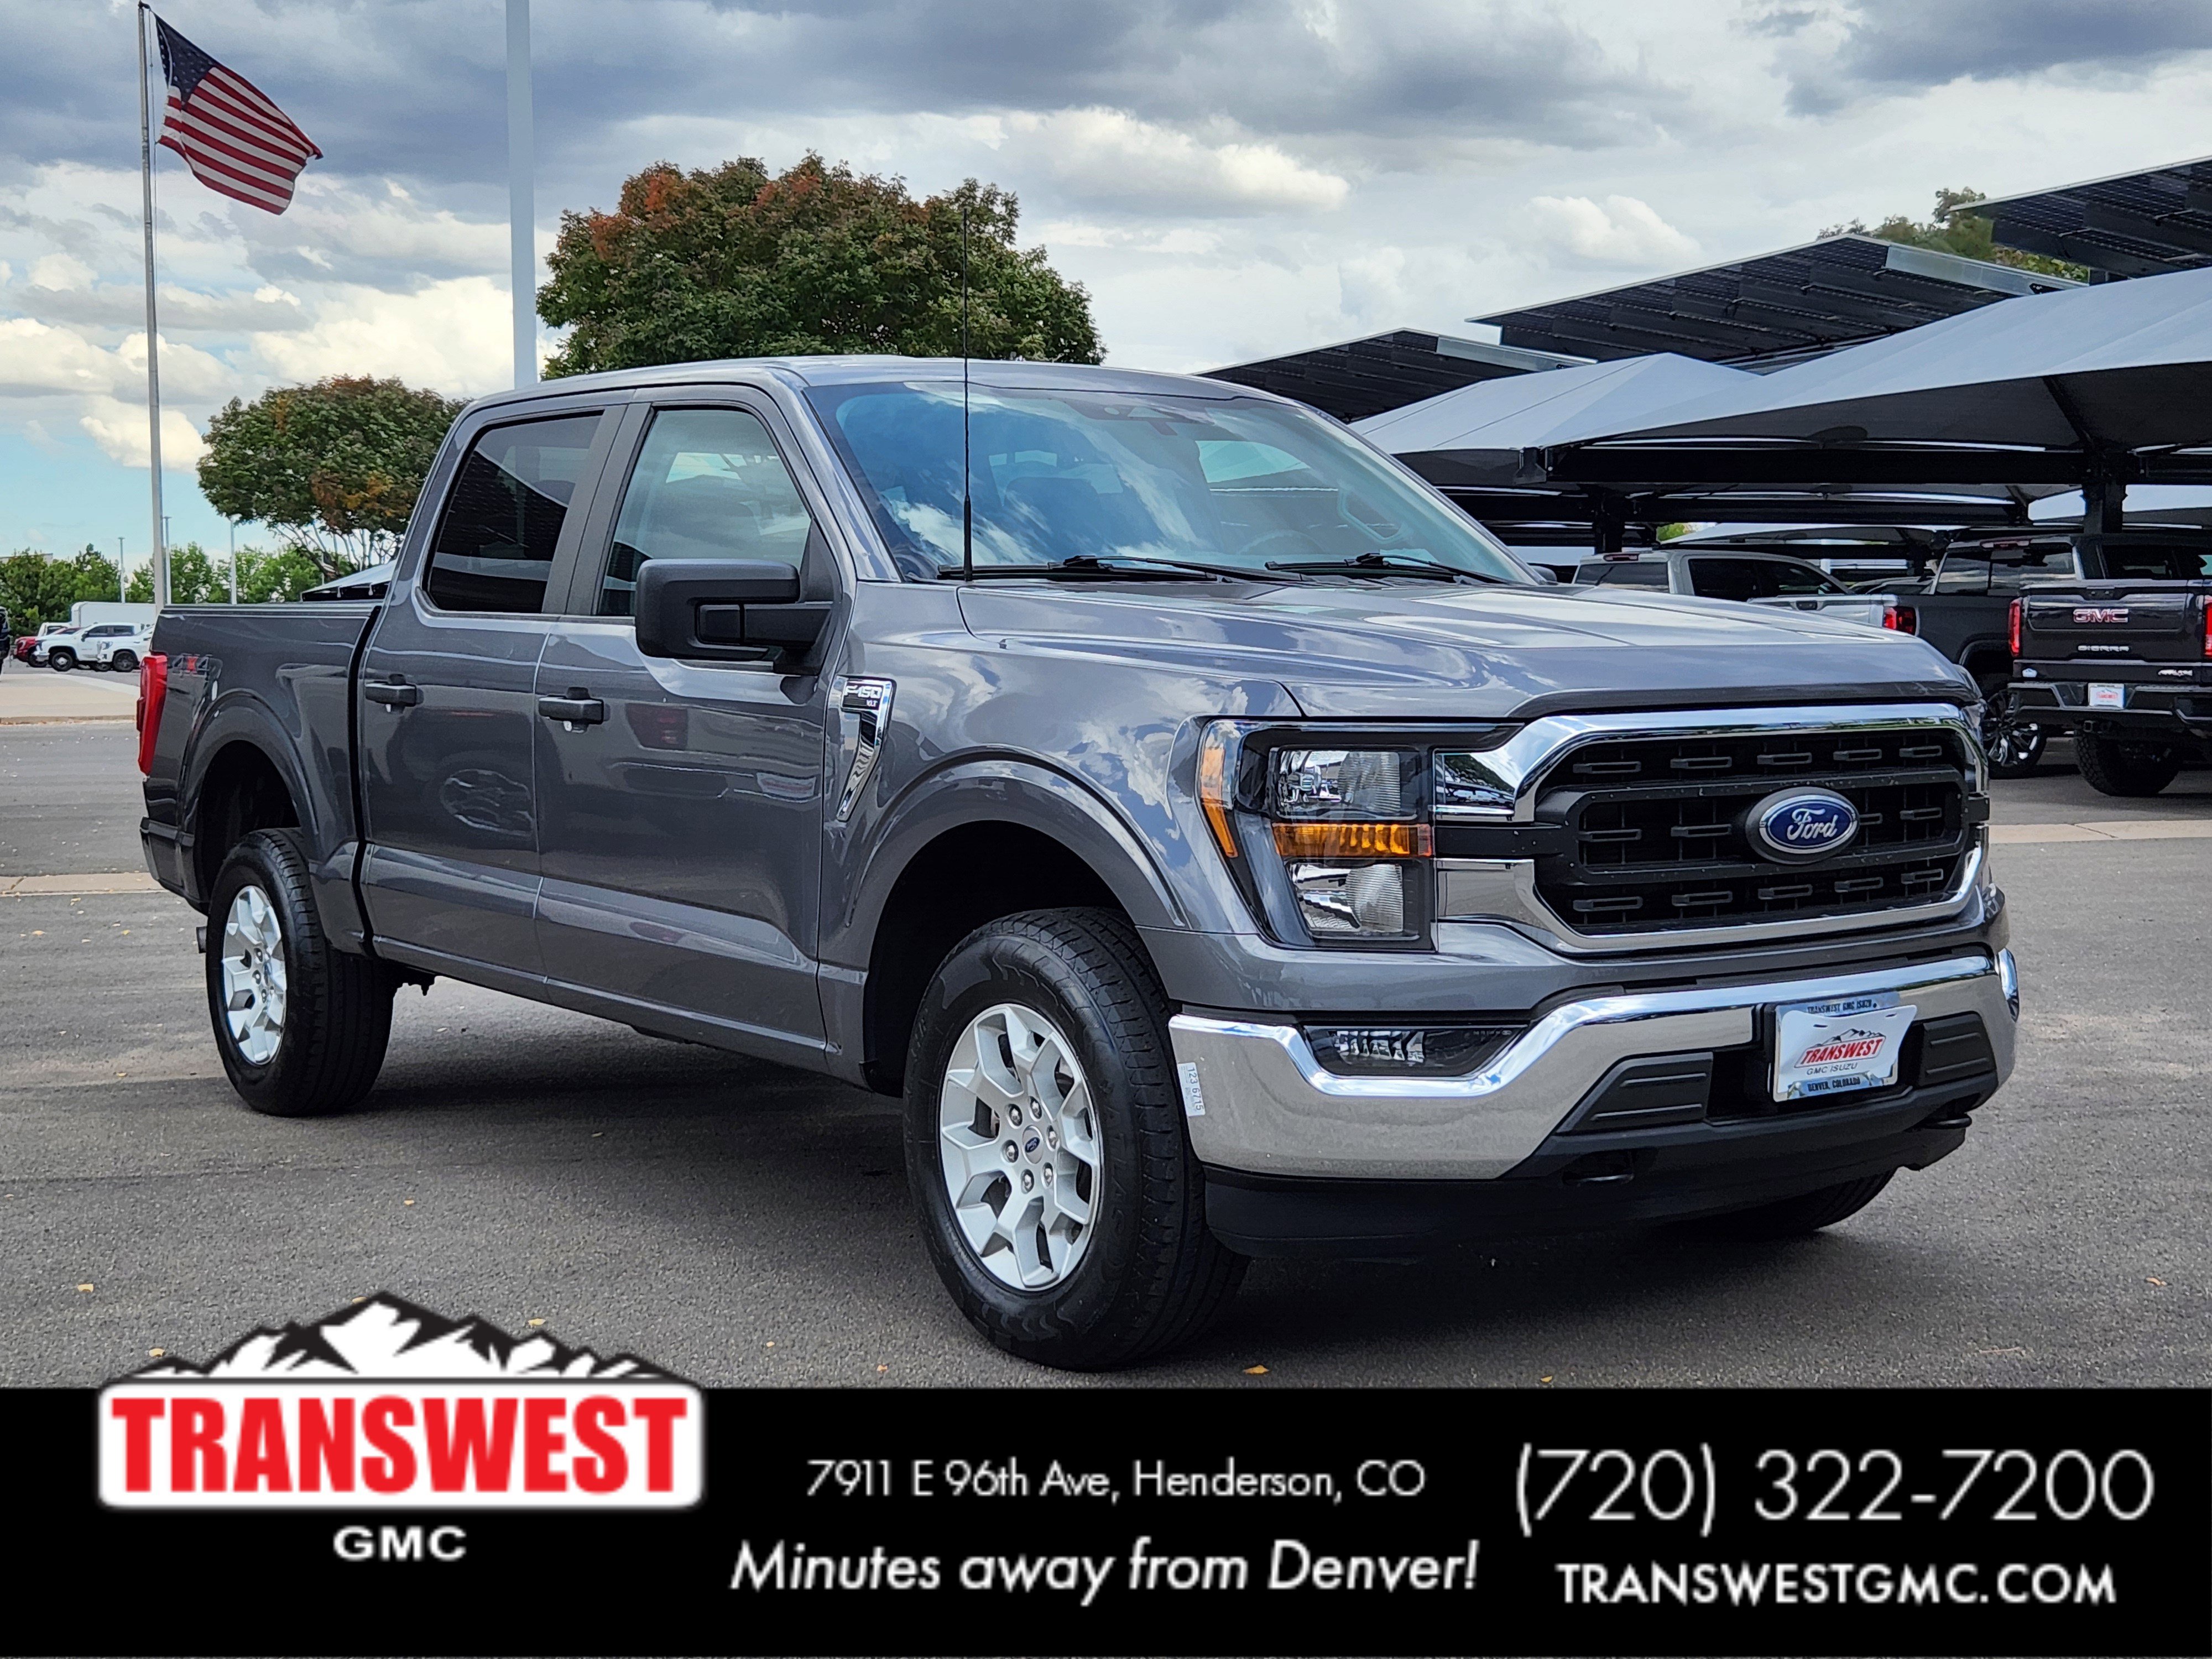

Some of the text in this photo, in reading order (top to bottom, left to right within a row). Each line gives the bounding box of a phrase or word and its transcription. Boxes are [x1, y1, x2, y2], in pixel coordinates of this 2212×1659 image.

[2073, 608, 2128, 623] GMC
[844, 685, 882, 699] F-150
[1786, 807, 1839, 841] Ford
[1800, 1038, 1884, 1065] TRANSWEST
[1806, 1062, 1858, 1076] GMC ISUZU
[1187, 1067, 1204, 1111] 123 6715
